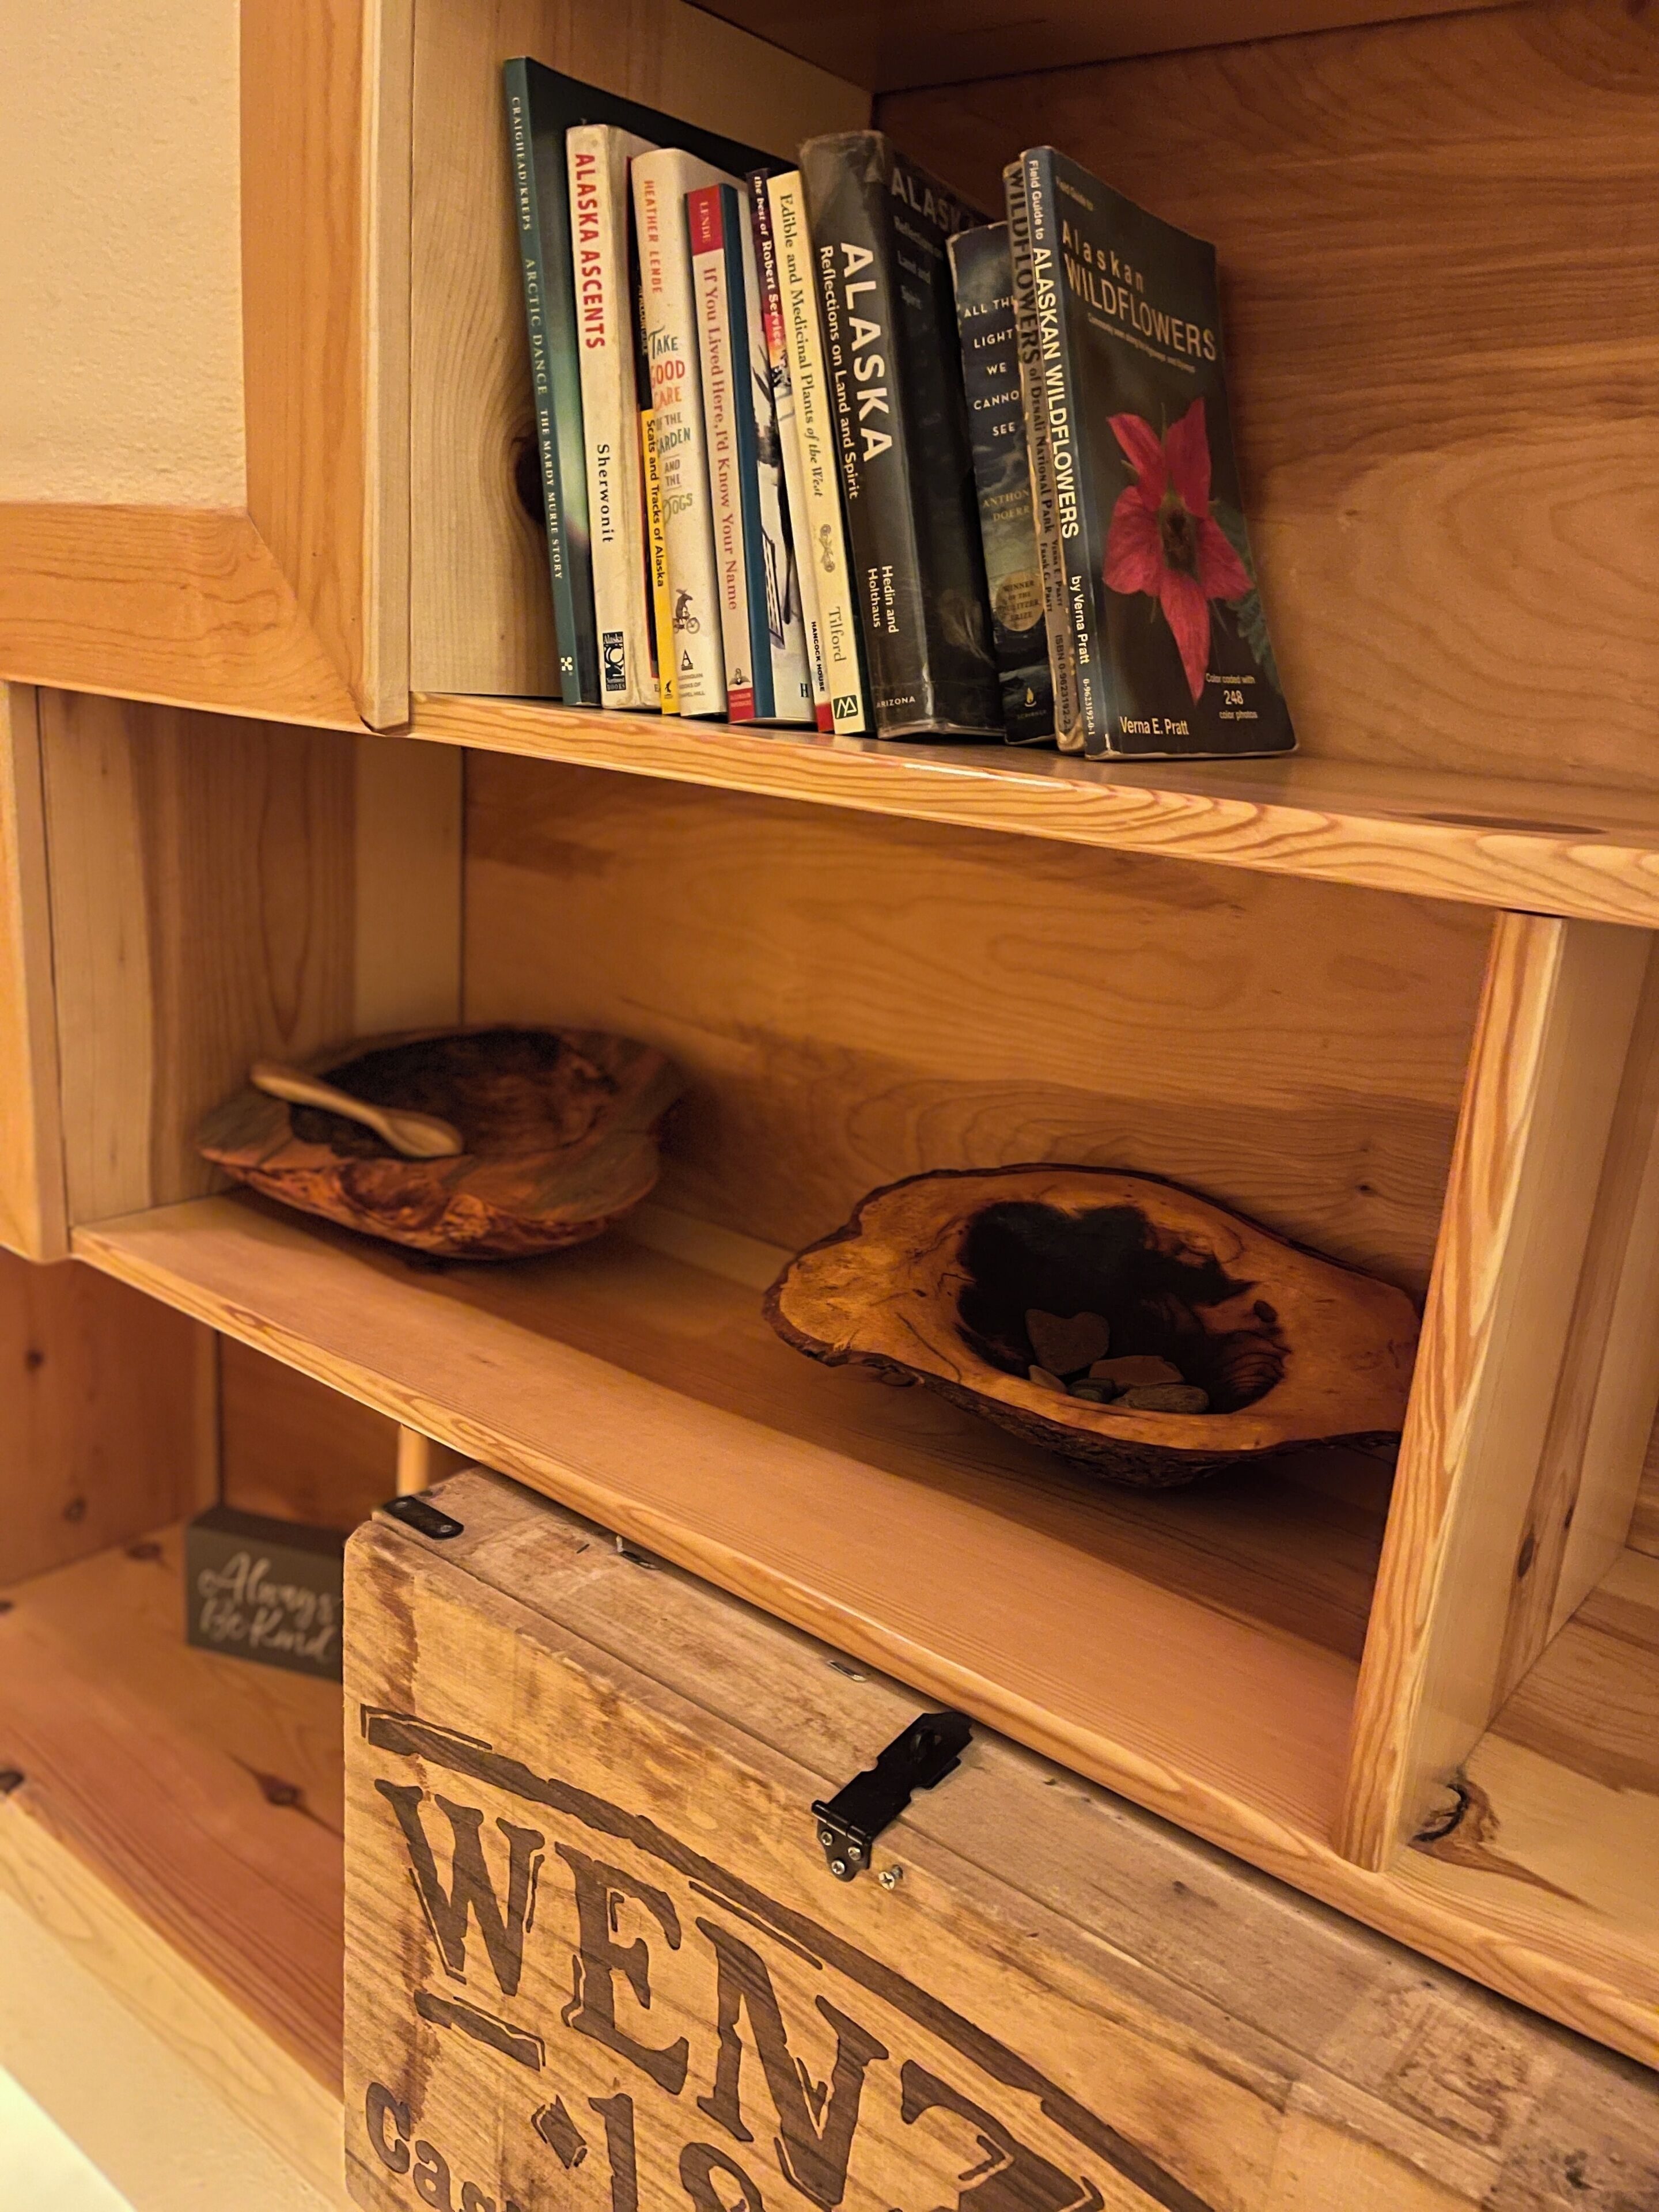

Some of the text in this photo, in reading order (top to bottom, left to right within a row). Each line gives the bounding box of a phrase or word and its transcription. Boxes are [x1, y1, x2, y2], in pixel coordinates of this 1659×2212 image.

[512, 97, 531, 230] CRAIGHEAD/KREPS
[575, 154, 605, 349] ALASKA ASCENTS
[644, 180, 662, 294] HEATHER LENDE
[699, 200, 712, 245] LENDE
[762, 240, 777, 290] Robert
[1009, 167, 1041, 364] WILDFLOWERS
[1062, 219, 1144, 293] Alaskan
[525, 259, 547, 395] ARCTIC DANCE
[768, 293, 783, 347] Service
[964, 303, 988, 318] ALL
[1064, 252, 1217, 362] WILDFLOWERS
[779, 193, 824, 497] Edible and Medicinal Plants of the West
[840, 242, 893, 463] ALASKA
[974, 328, 1013, 349] LIGHT
[986, 362, 1007, 375] WE
[1029, 160, 1080, 539] Field Guide to ALASKAN WILDFLOWERS
[820, 245, 859, 500] Reflections on Land and Spirit
[974, 390, 1020, 410] CANNO
[664, 412, 683, 426] THE
[703, 267, 737, 611] If You Lived Here, I'd Know Your Name
[992, 421, 1016, 437] SEE
[540, 409, 563, 579] THE MARDY MURIE STORY
[597, 444, 615, 543] Sherwonit
[665, 459, 681, 474] AND
[665, 474, 681, 487] THE
[647, 419, 665, 588] Scats and Tracks of Alaska
[662, 493, 694, 525] DOGS
[983, 489, 1030, 507] ANTHON
[993, 505, 1030, 522] DOERR
[868, 567, 881, 628] Holthaus
[881, 565, 899, 634] Hedin and
[1070, 575, 1090, 665] by Verna Pratt
[811, 621, 825, 692] HANCOCK HOUSE
[828, 606, 847, 662] Tilford
[1055, 634, 1065, 661] ISBN
[876, 695, 916, 709] ARIZONA
[1119, 715, 1190, 736] Verna E. Pratt
[1223, 690, 1244, 704] 248
[196, 1551, 334, 1631] Always
